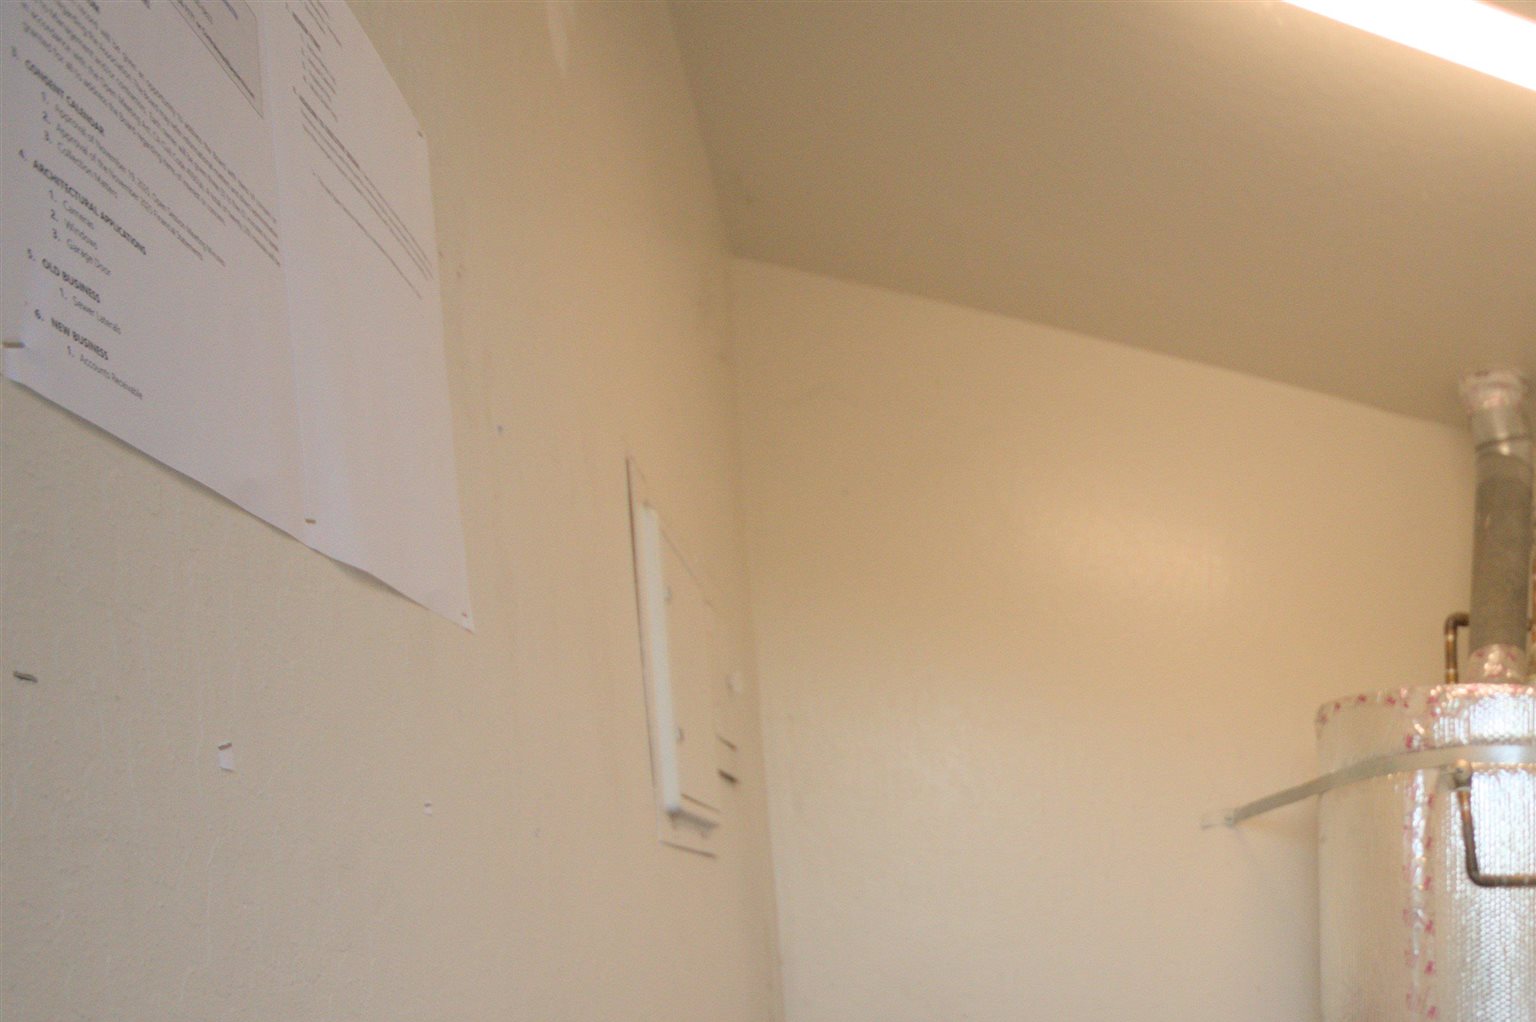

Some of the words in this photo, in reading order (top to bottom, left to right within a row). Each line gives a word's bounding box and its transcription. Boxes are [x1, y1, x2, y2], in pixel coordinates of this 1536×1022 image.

[33, 160, 99, 217] ARCHITECTURAL
[100, 211, 147, 256] APPLICATIONS
[41, 257, 61, 277] OLD
[61, 270, 101, 304] BUSINESS
[51, 317, 71, 337] NEW
[71, 330, 109, 361] BUSINESS
